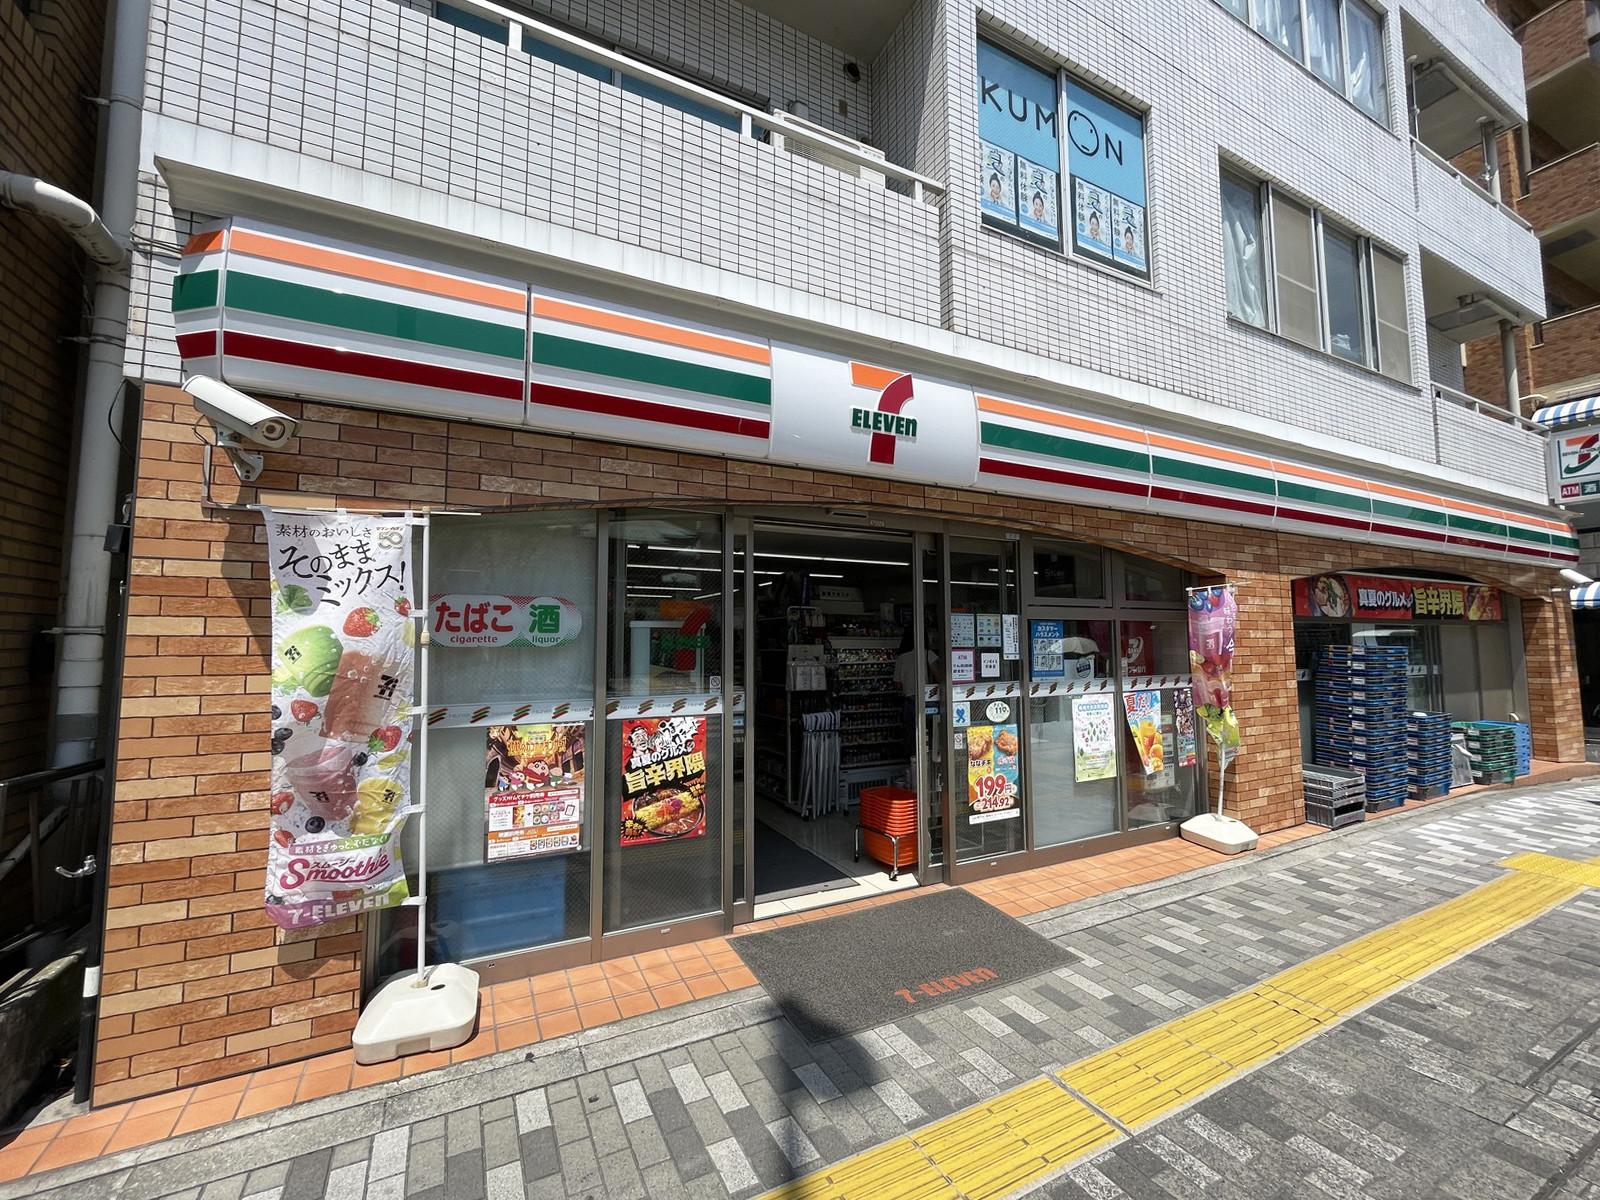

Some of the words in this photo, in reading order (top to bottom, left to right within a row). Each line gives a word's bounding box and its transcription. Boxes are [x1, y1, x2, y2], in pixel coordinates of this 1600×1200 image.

[981, 76, 1123, 165] KUMON
[851, 407, 917, 437] ELEVEN
[1561, 486, 1580, 497] ATM
[276, 523, 372, 538] 素材のおいしさ
[279, 539, 376, 578] そのまま
[316, 560, 406, 607] ミックス!
[1412, 585, 1465, 615] 旨辛界隈
[435, 601, 514, 633] たばこ
[529, 604, 560, 633] 酒
[449, 634, 498, 644] cigarette
[531, 634, 561, 644] liquor
[624, 750, 706, 793] 旨辛界隈
[982, 796, 1010, 810] 214.92
[279, 853, 389, 890] Smoothie
[311, 857, 356, 869] スムージー
[287, 893, 390, 925] 7-ELEVEN
